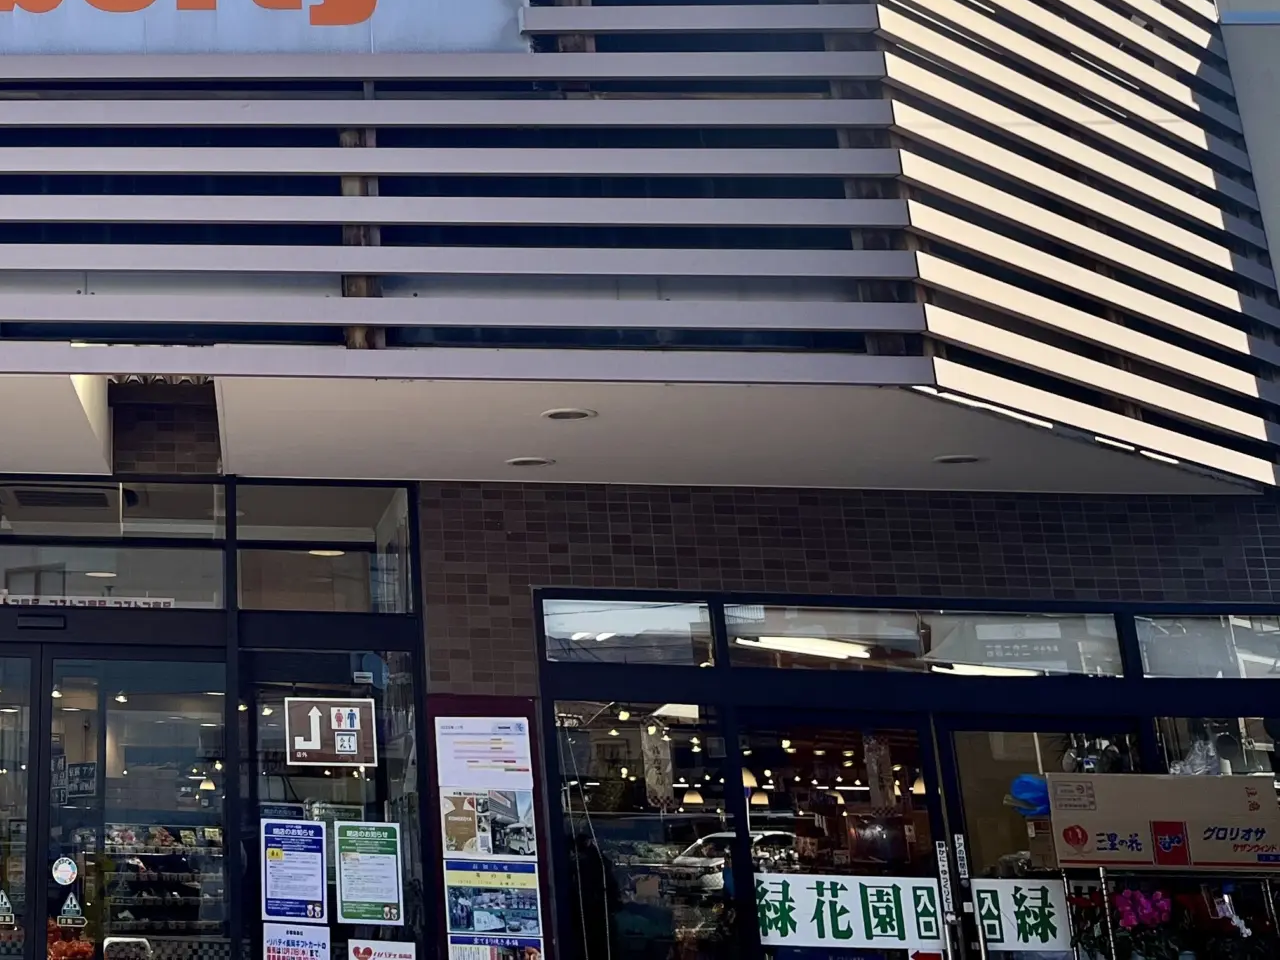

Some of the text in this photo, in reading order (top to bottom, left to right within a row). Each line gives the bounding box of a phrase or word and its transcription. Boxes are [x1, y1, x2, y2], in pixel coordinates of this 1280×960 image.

[1202, 826, 1267, 841] グロリオサ
[756, 878, 907, 941] 緑花園
[915, 888, 939, 939] 入口
[979, 890, 1001, 940] 入口
[1013, 885, 1058, 943] 緑
